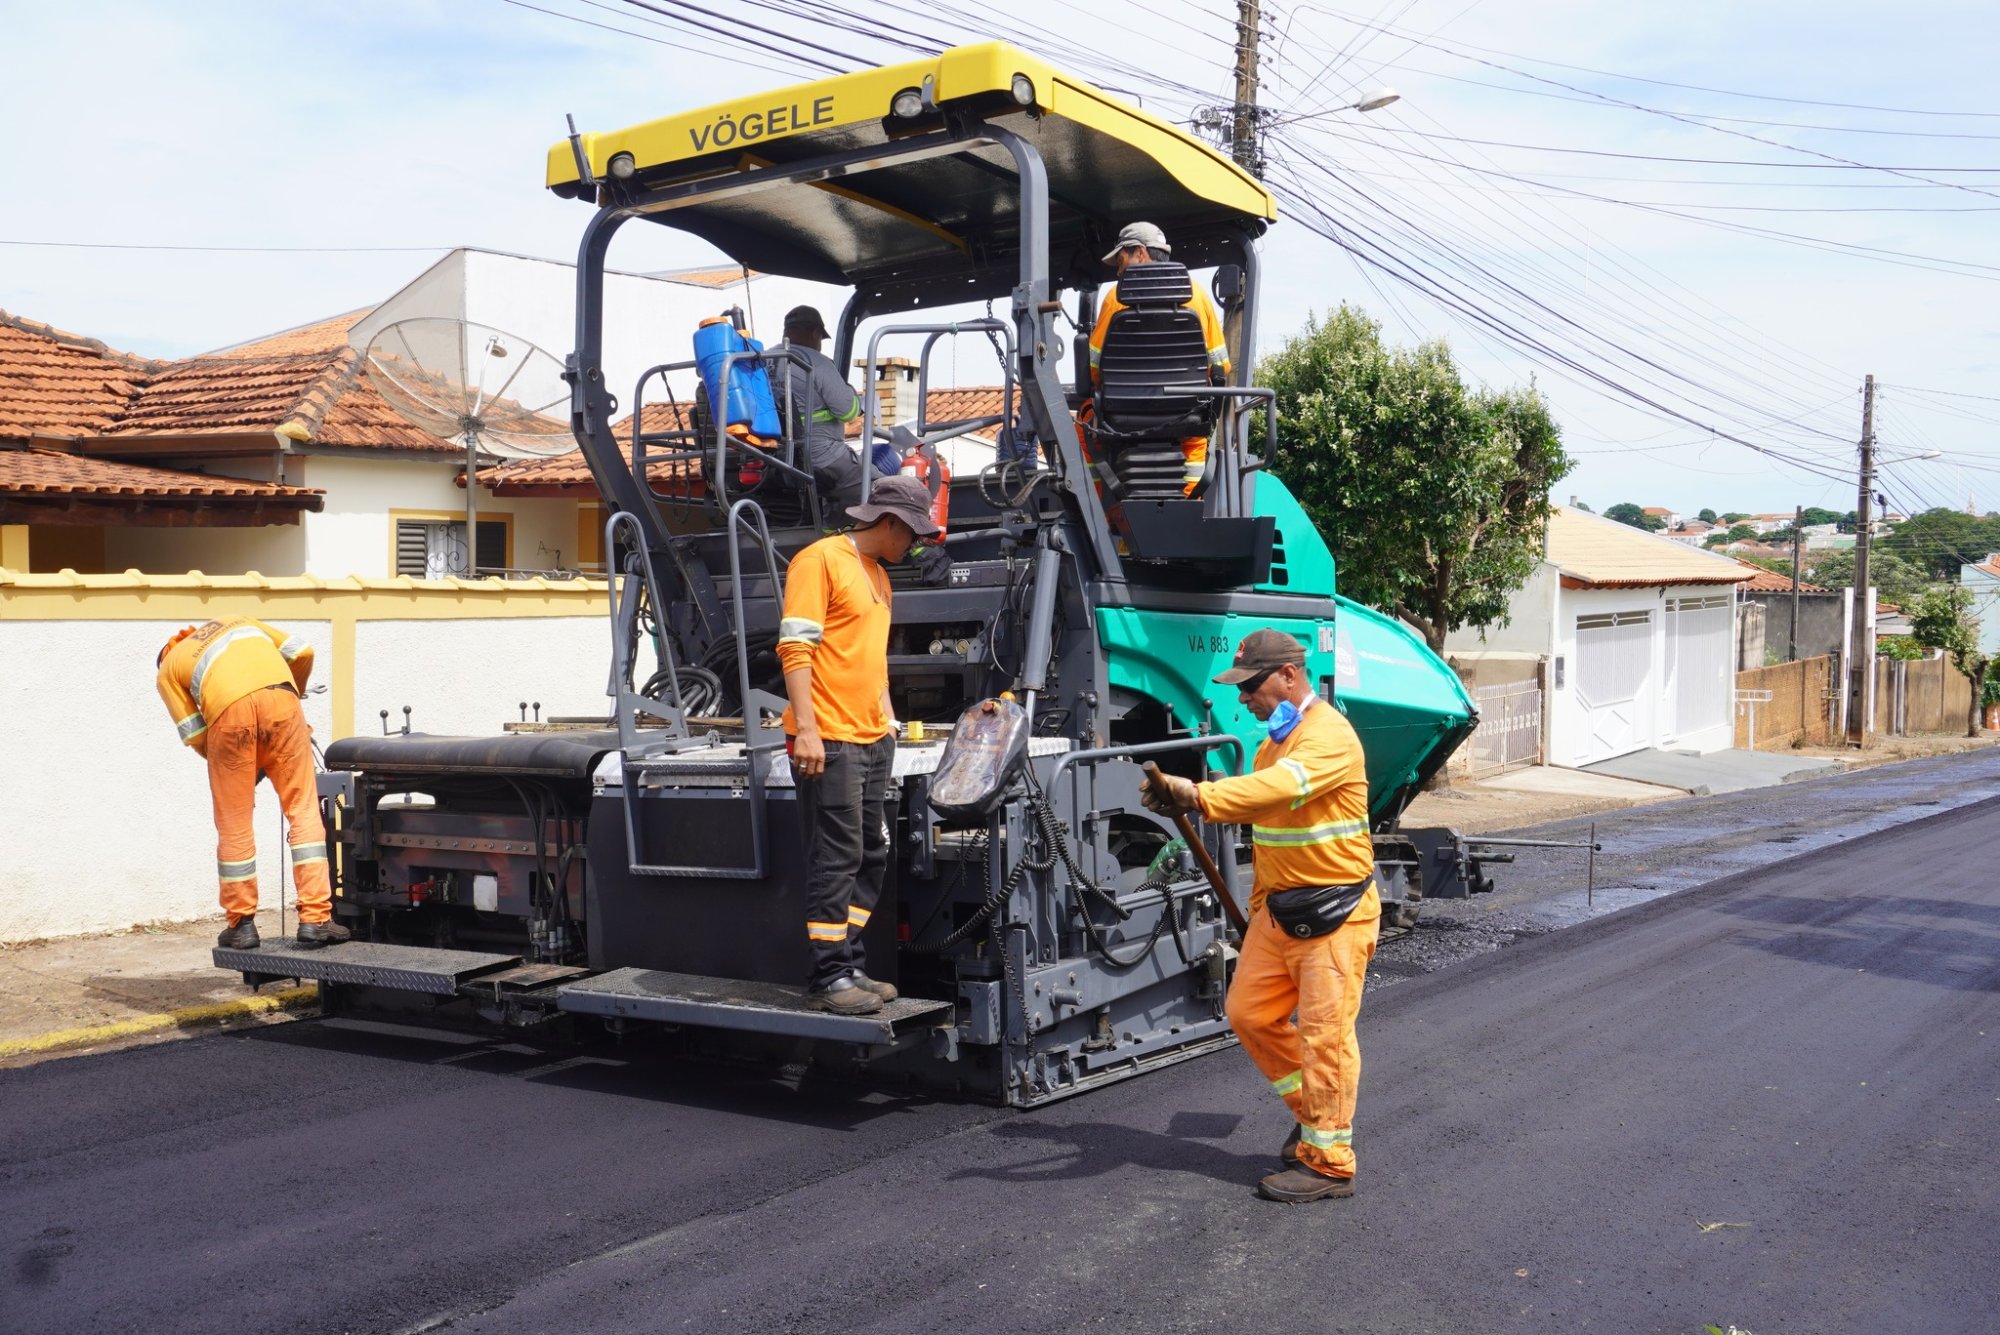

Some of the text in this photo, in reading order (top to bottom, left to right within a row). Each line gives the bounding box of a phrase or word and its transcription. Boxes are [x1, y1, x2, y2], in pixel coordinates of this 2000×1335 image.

[690, 95, 834, 151] VÖGELE
[1187, 635, 1206, 653] VA
[1210, 635, 1229, 653] 883
